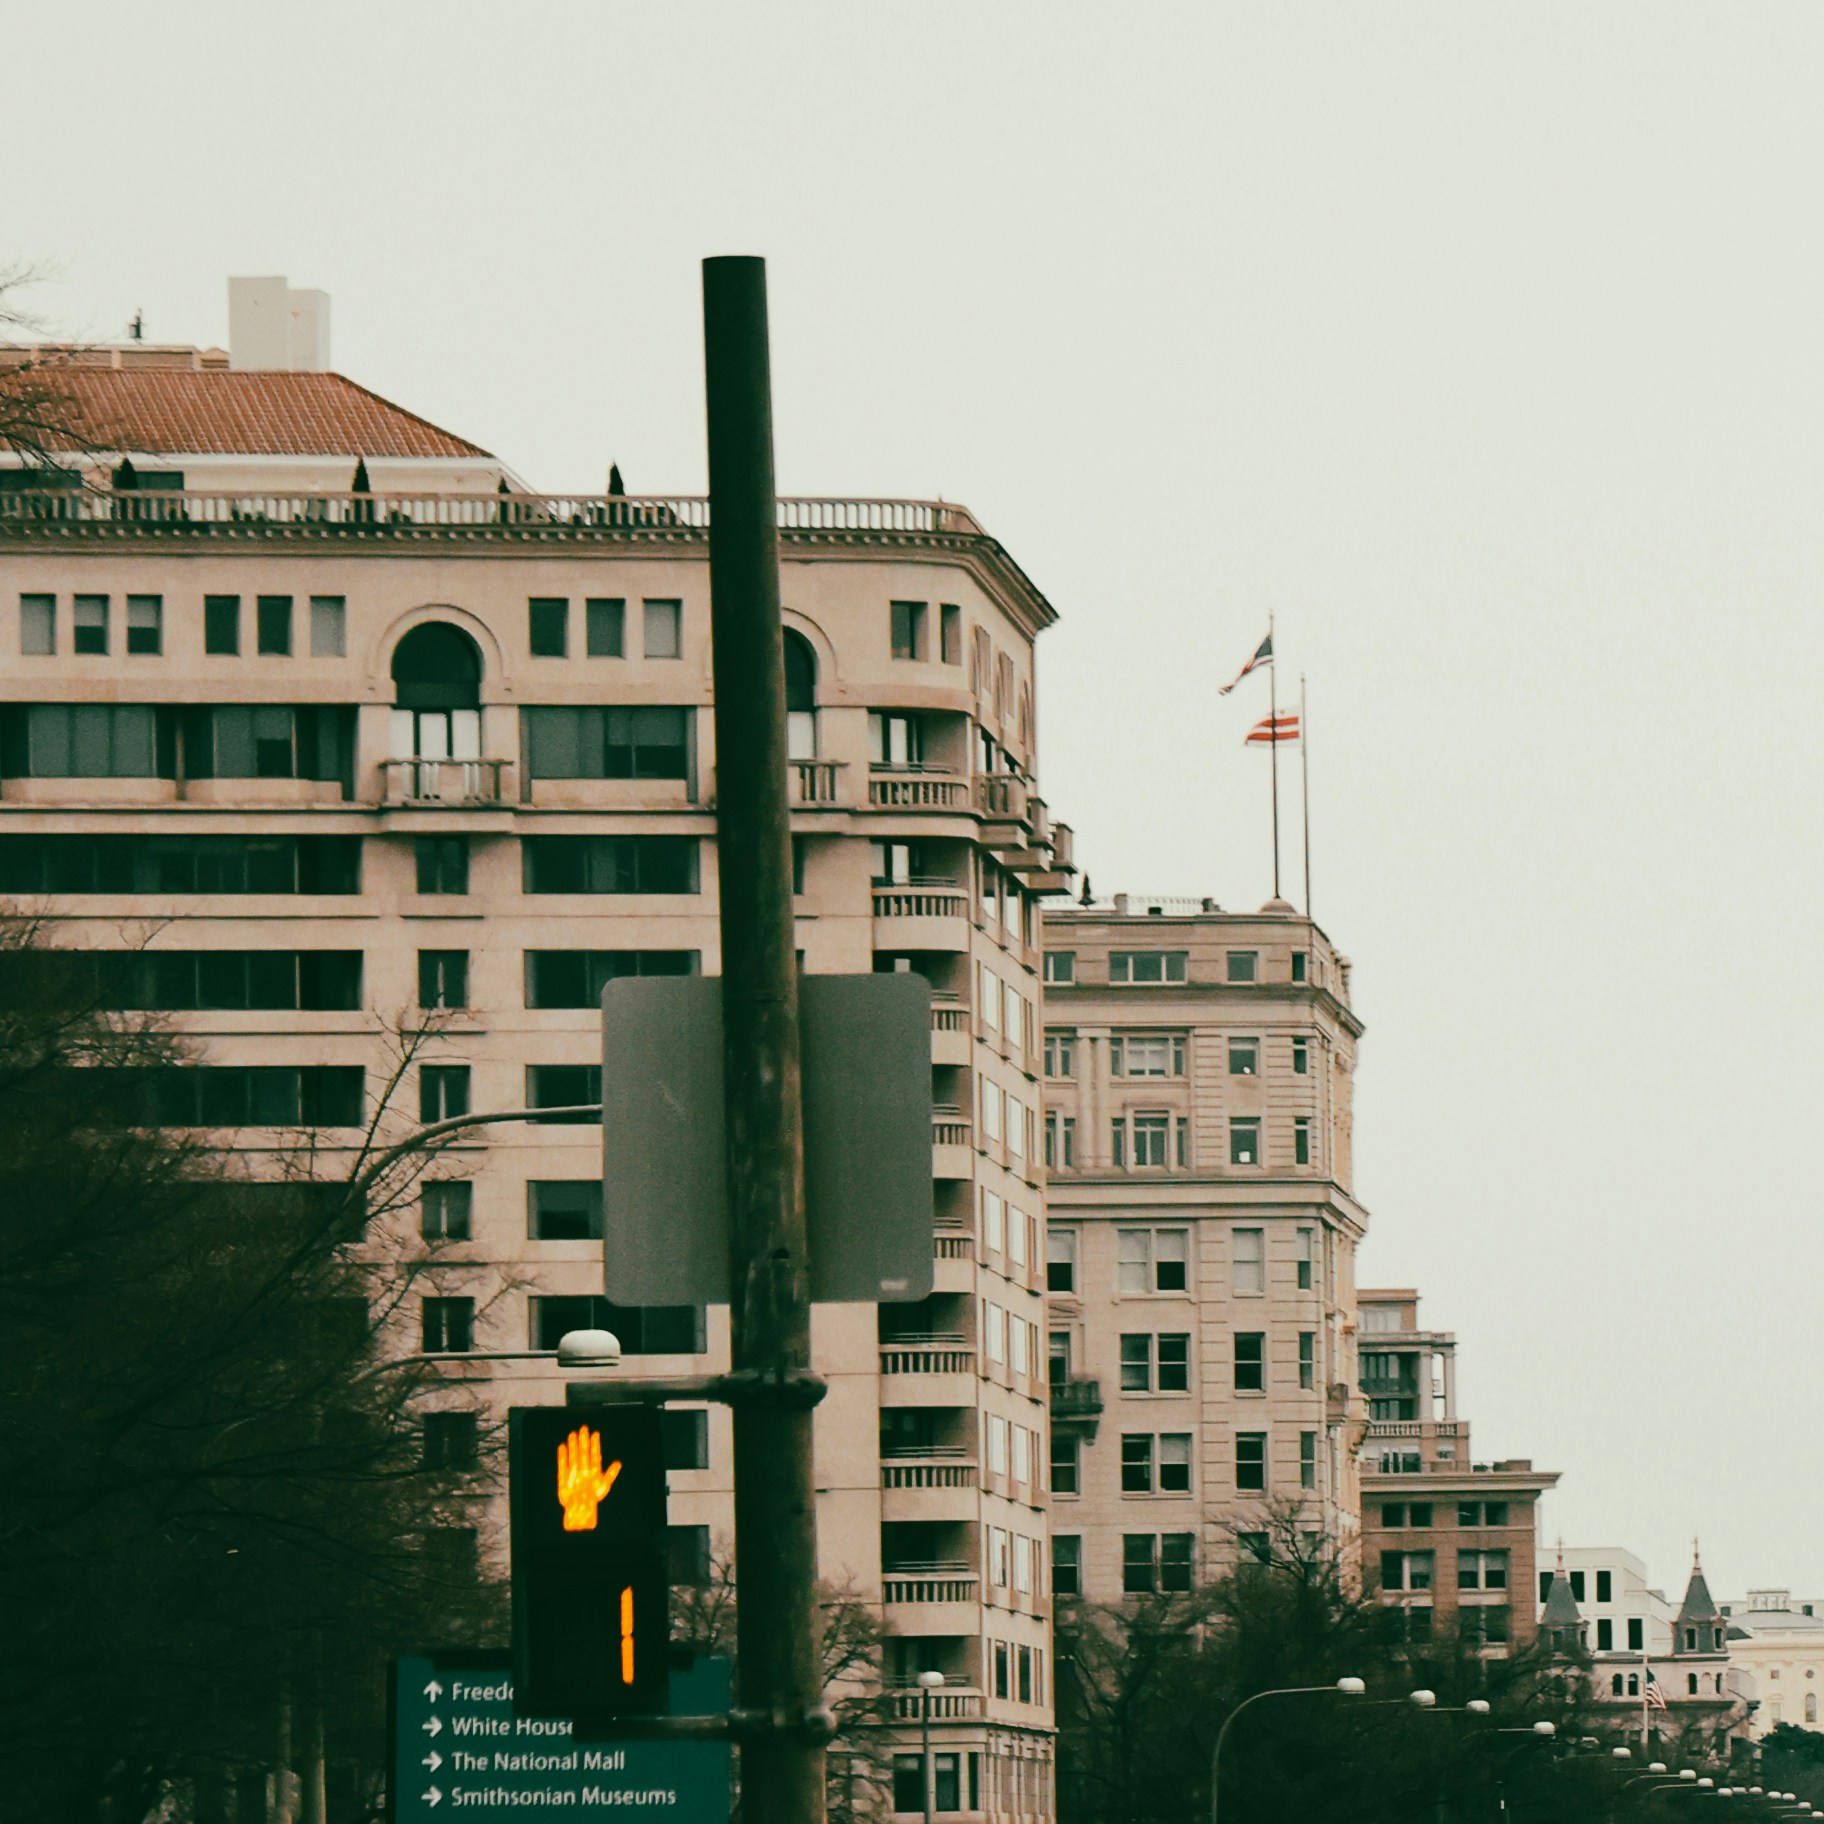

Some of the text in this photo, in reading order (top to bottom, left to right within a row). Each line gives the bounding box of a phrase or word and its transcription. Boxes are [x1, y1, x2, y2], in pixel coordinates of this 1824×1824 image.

[452, 1716, 511, 1736] White
[452, 1750, 625, 1771] The National Mall
[451, 1786, 677, 1806] Smithsonian Museums
